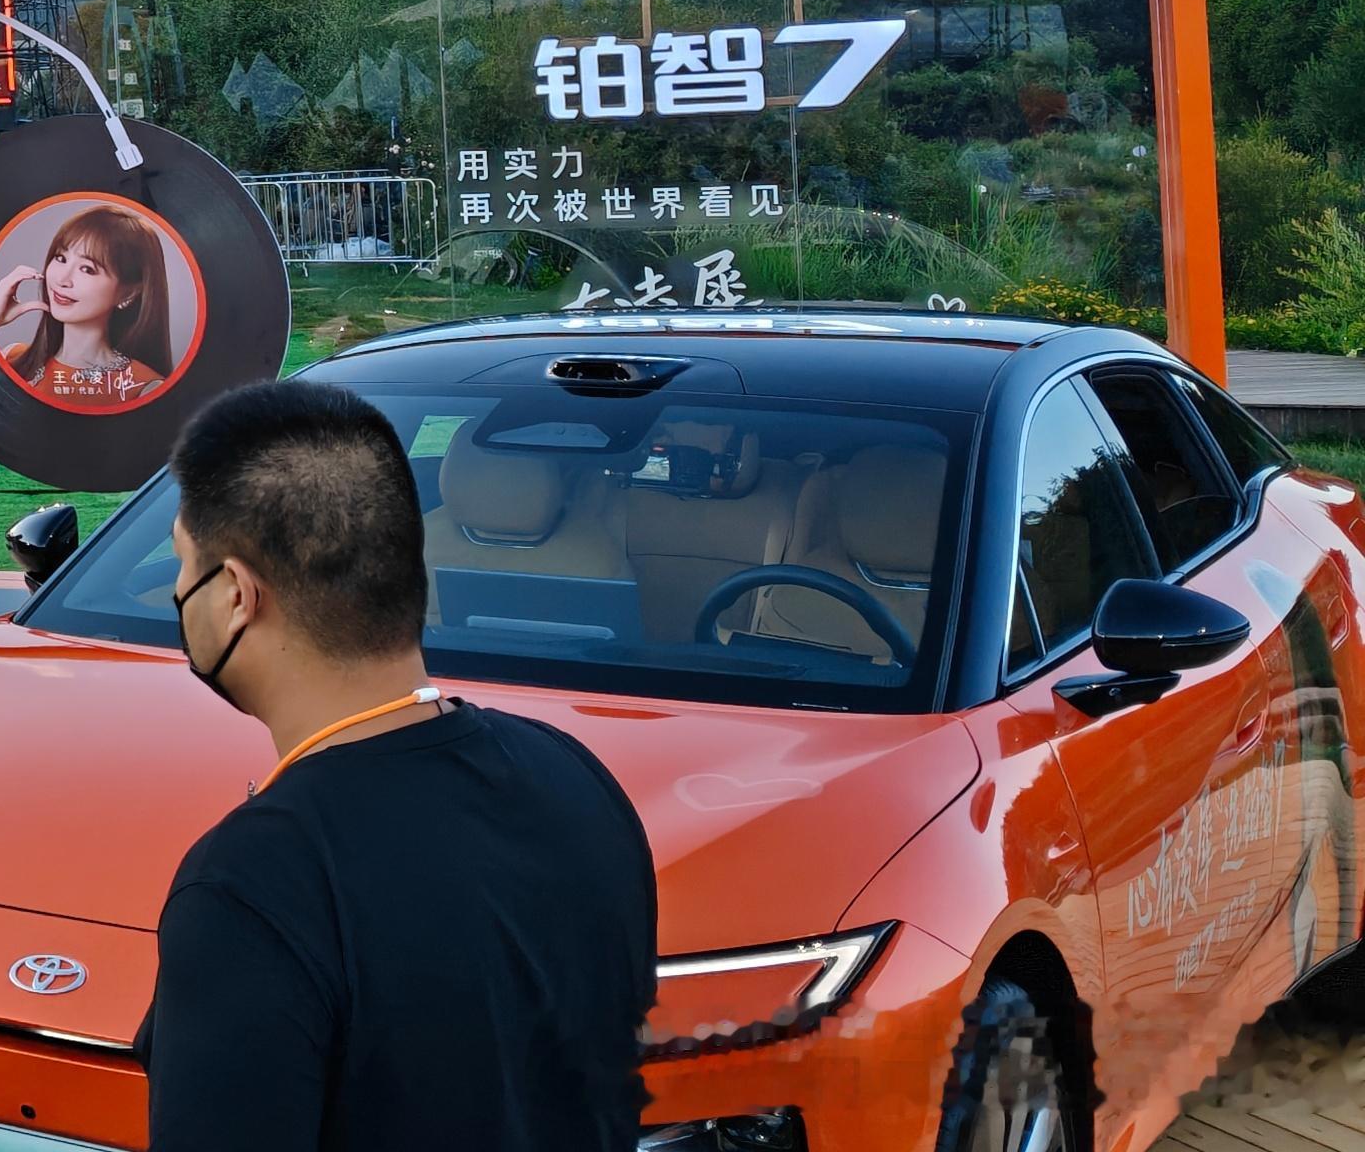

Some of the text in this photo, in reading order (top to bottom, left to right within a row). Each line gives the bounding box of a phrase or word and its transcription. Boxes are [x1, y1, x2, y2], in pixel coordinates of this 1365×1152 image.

[533, 19, 907, 120] 铂智7
[457, 146, 584, 182] 用实力
[459, 183, 784, 225] 再次被世界看见
[52, 370, 104, 384] 王心凌
